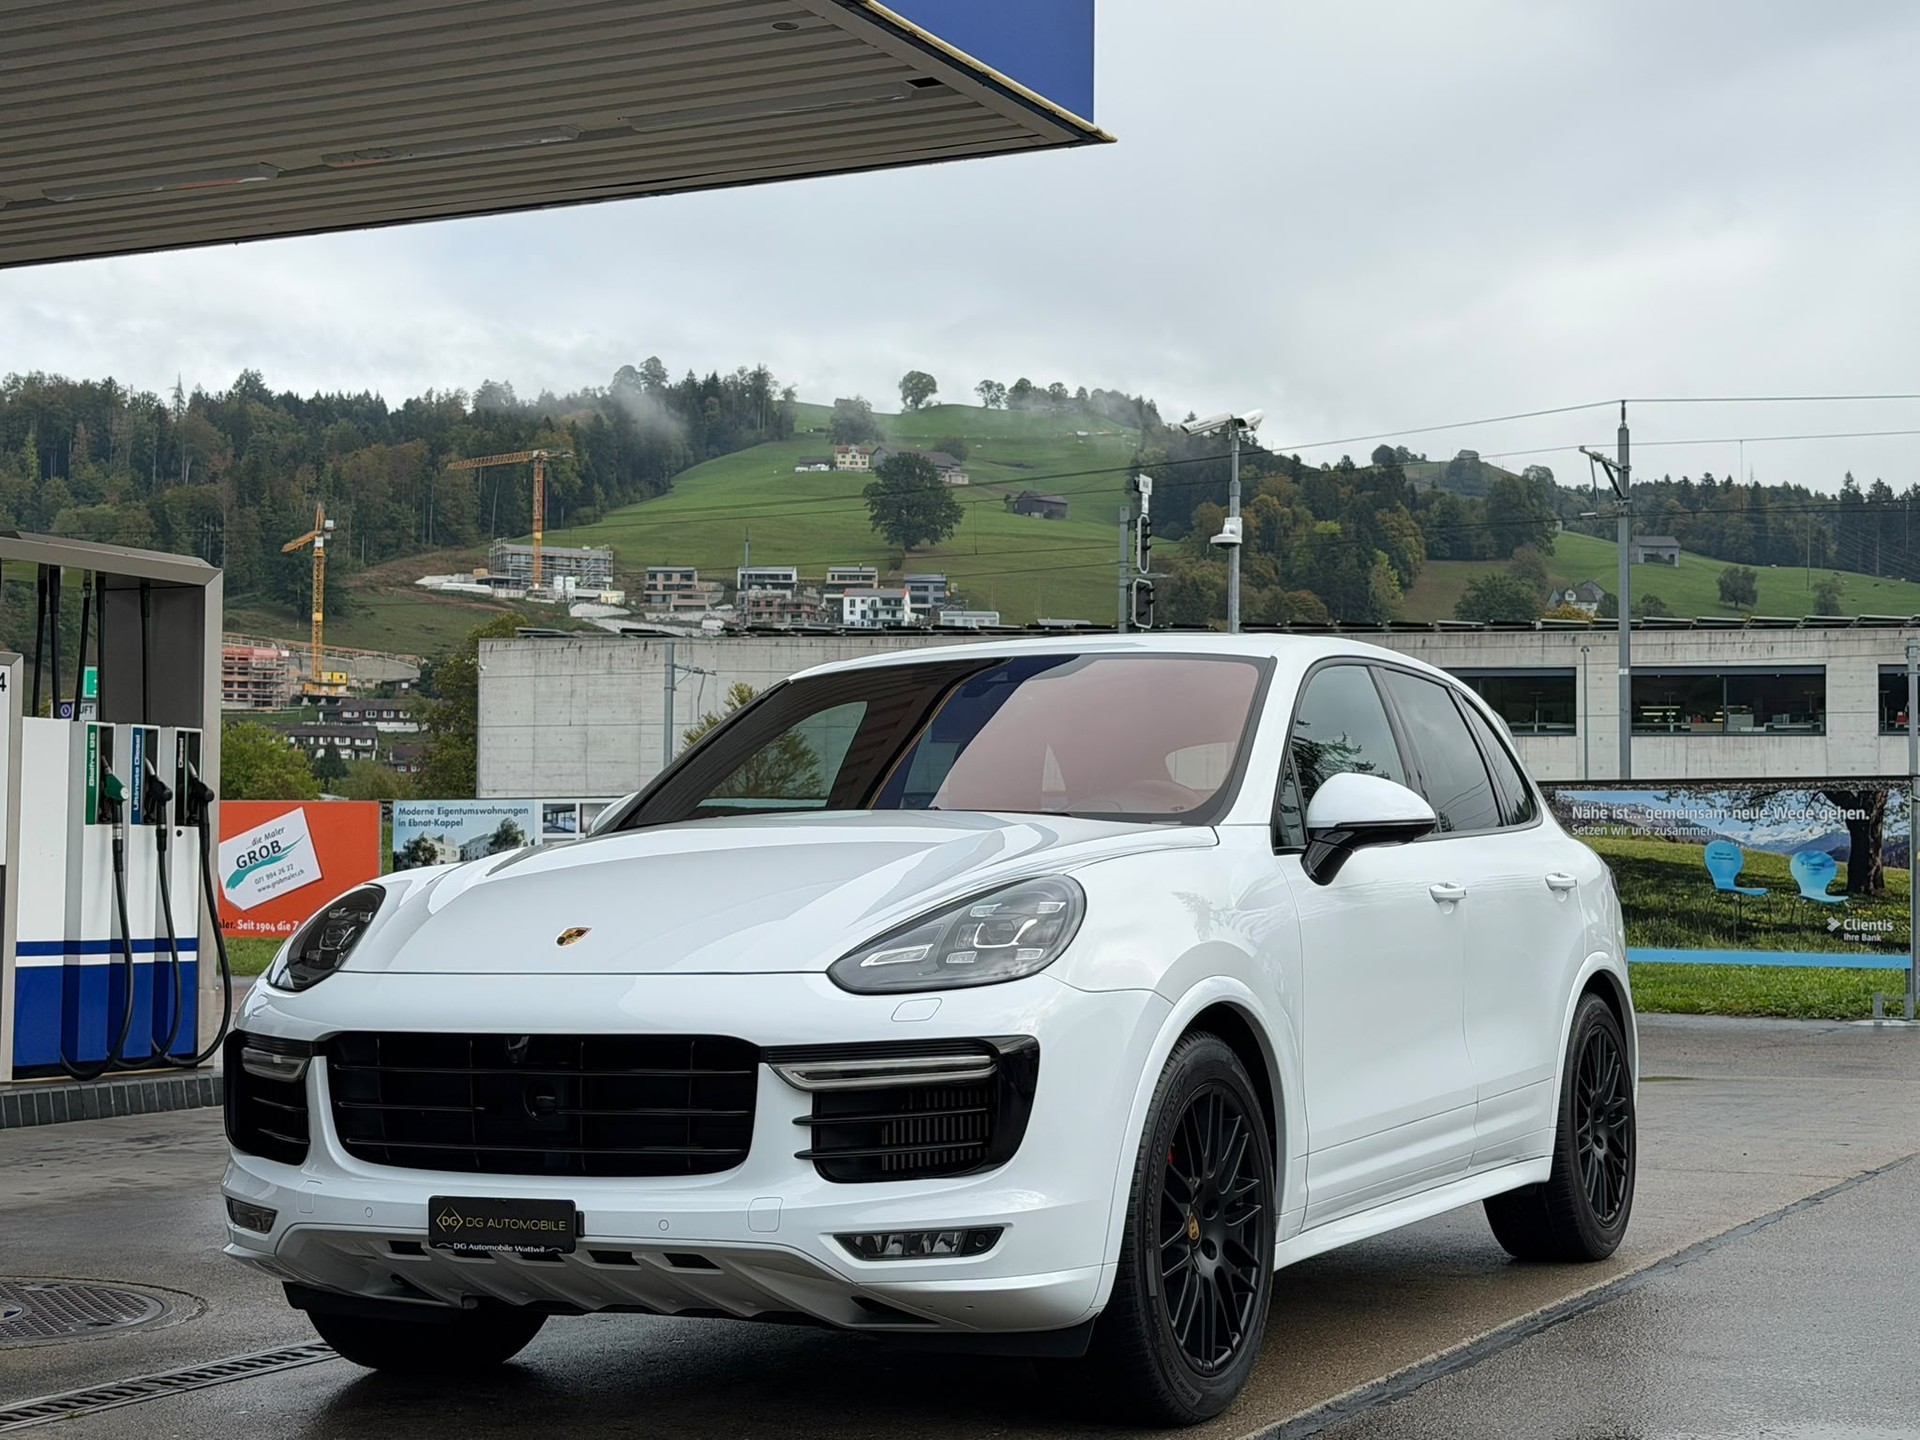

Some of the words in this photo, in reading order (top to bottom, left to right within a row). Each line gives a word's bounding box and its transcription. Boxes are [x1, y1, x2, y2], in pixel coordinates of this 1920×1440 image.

[133, 767, 141, 811] Ultimate
[398, 807, 434, 816] Moderne
[437, 806, 529, 817] Eigentumswohnungen
[1572, 806, 1608, 820] Nähe
[1612, 807, 1641, 820] ist...
[1645, 807, 1727, 822] gemeinsam
[1733, 807, 1768, 820] neue
[1773, 807, 1814, 822] Wege
[1819, 806, 1870, 822] gehen.
[398, 819, 406, 827] in
[408, 818, 464, 829] Ebnat-Kappel
[264, 827, 285, 841] Maler
[1571, 824, 1608, 836] Setzen
[1611, 825, 1628, 836] wir
[1632, 826, 1651, 836] uns
[1654, 826, 1717, 837] zusammen.
[236, 840, 282, 868] GROB
[237, 919, 255, 930] Seit
[256, 922, 276, 933] 1904
[277, 920, 291, 931] die
[1843, 919, 1894, 932] Clientis
[1843, 933, 1860, 941] Ihre
[1861, 933, 1882, 942] Bank
[442, 1216, 458, 1227] DG
[465, 1217, 484, 1228] DG
[487, 1218, 567, 1231] AUTOMOBILE
[453, 1242, 467, 1250] DG
[469, 1243, 513, 1252] Automobile
[515, 1244, 545, 1253] Wattwil
